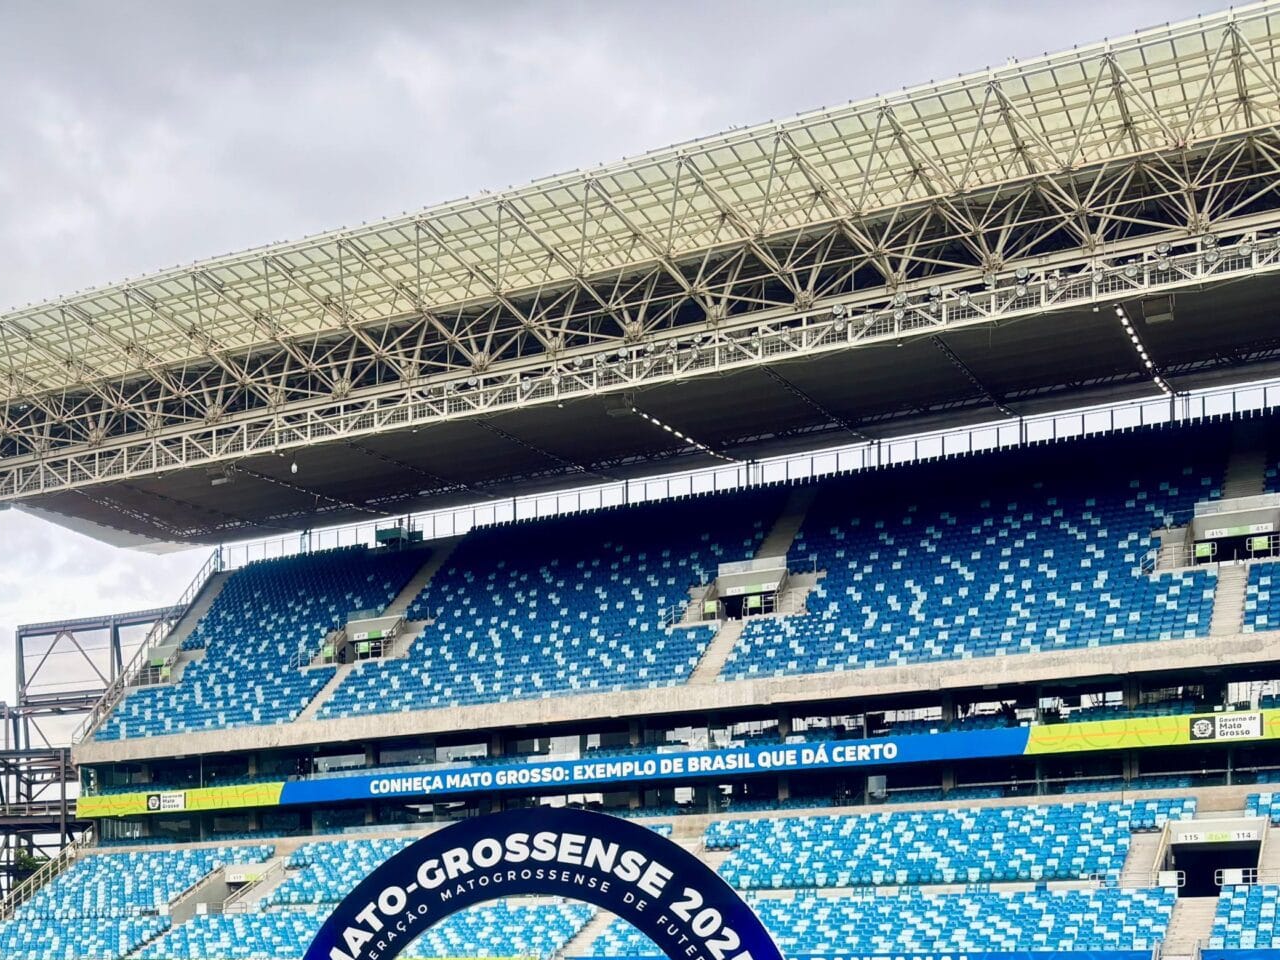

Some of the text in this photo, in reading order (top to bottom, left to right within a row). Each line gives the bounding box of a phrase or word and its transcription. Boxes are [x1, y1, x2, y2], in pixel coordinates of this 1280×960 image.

[1219, 729, 1250, 737] Grosso
[370, 742, 897, 794] CONHEÇA MATO GROSSO: EXEMPLO DE BRASIL QUE DÁ CERTO
[440, 868, 611, 902] MATOGROSSENSE
[623, 891, 646, 912] DE
